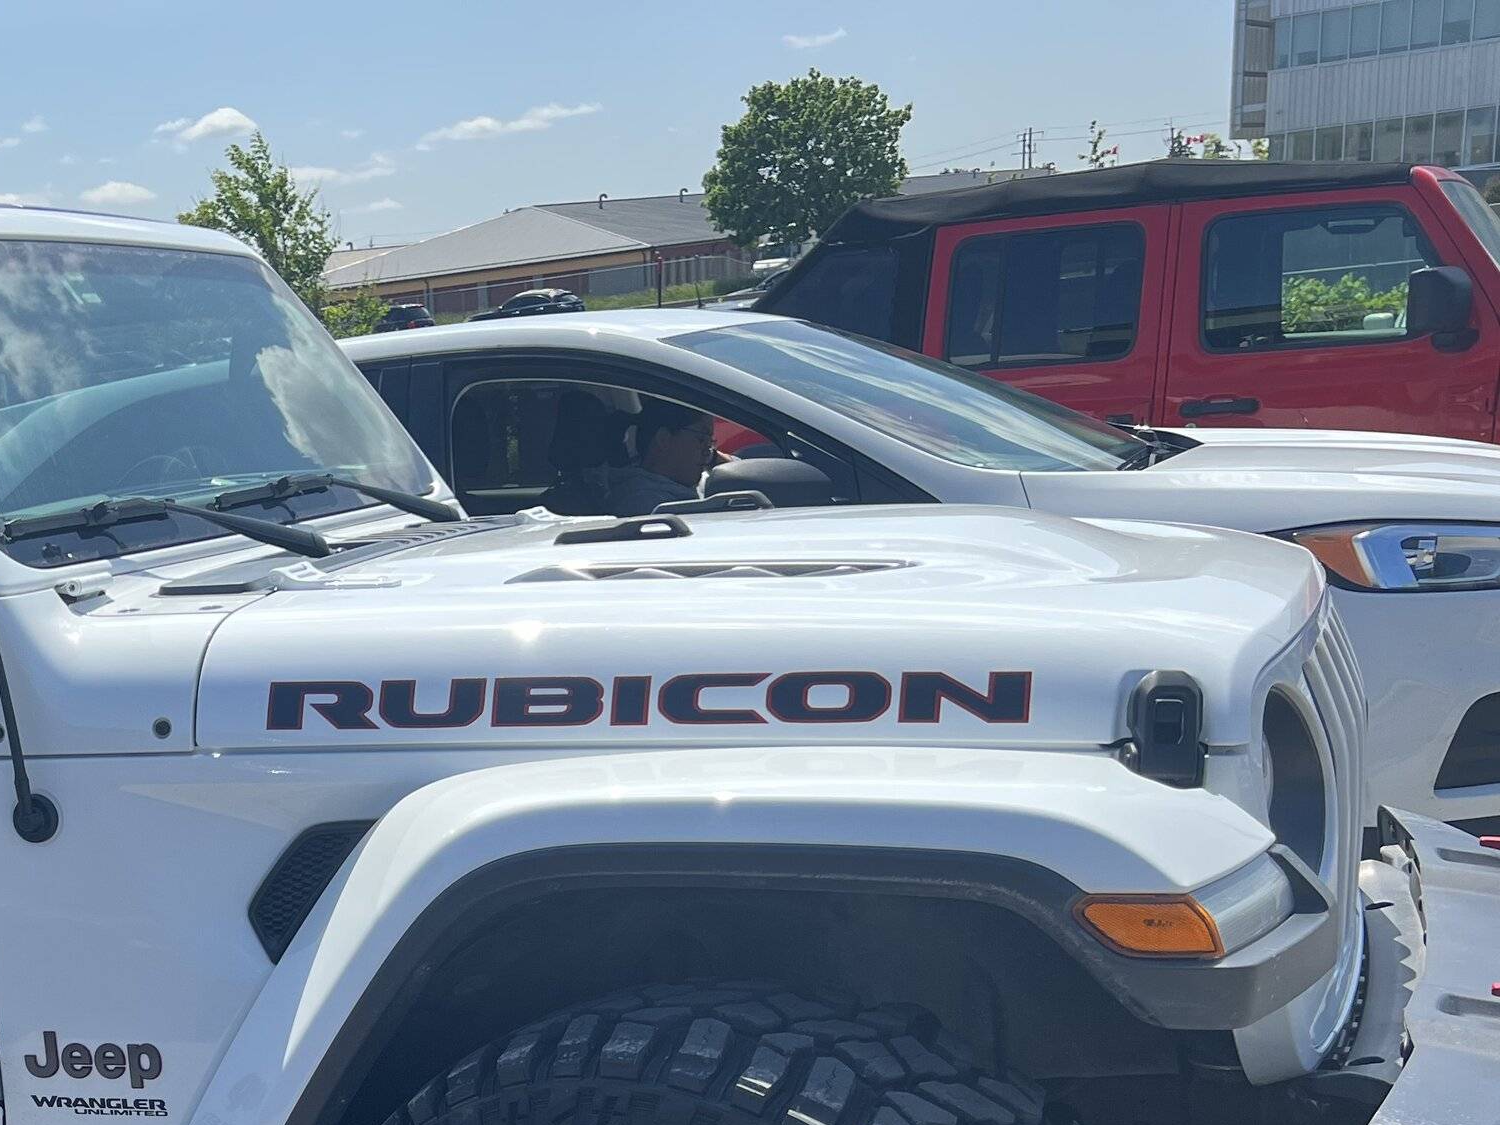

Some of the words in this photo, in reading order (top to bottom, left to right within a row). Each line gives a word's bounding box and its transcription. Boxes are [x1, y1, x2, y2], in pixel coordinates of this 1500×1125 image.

[265, 669, 1033, 731] RUBICON
[24, 1030, 163, 1089] Jeep
[30, 1094, 167, 1111] WRANGLER
[73, 1108, 169, 1117] UNLIMITED
